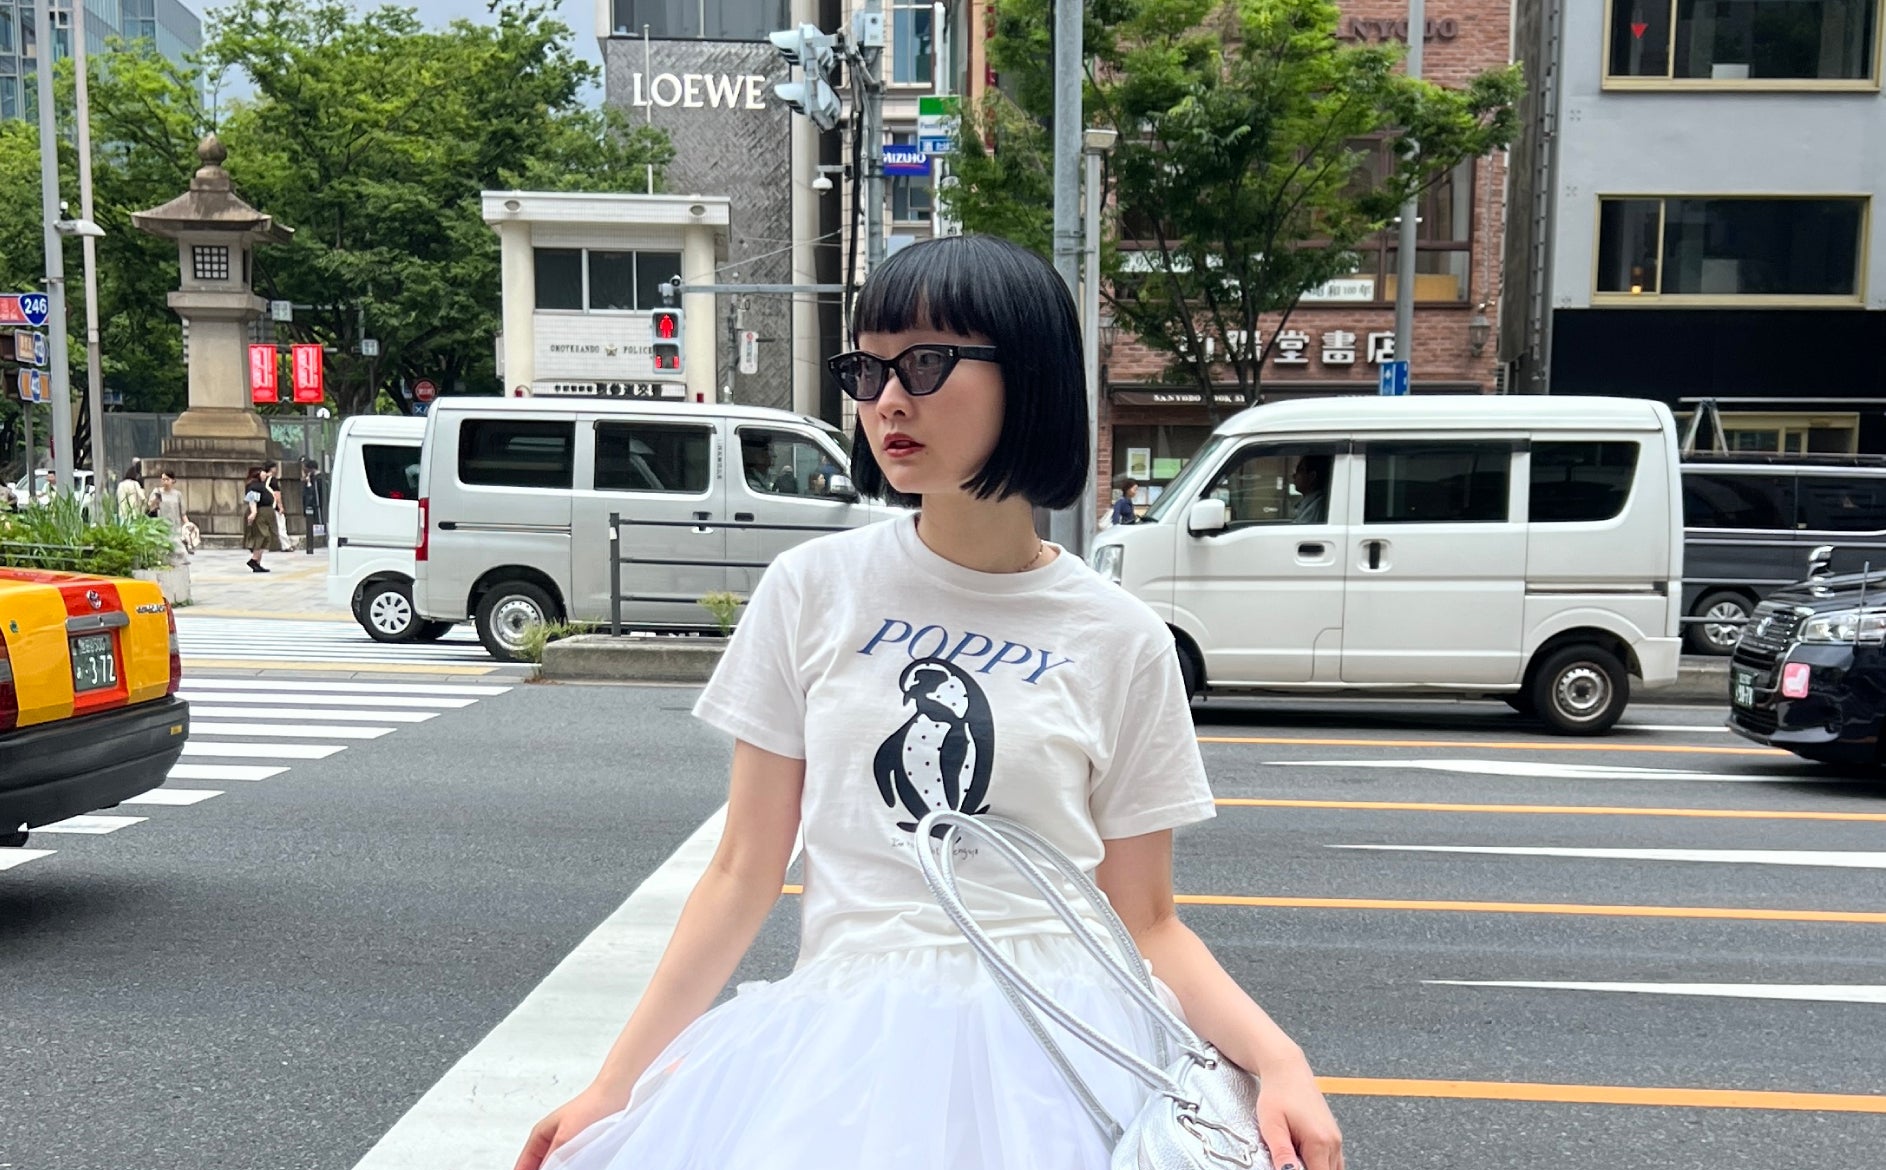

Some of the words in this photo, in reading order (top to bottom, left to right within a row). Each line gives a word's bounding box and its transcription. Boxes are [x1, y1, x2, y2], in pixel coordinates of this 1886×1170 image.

[633, 72, 766, 109] LOEWE
[24, 298, 47, 315] 246
[857, 618, 1075, 685] POPPY
